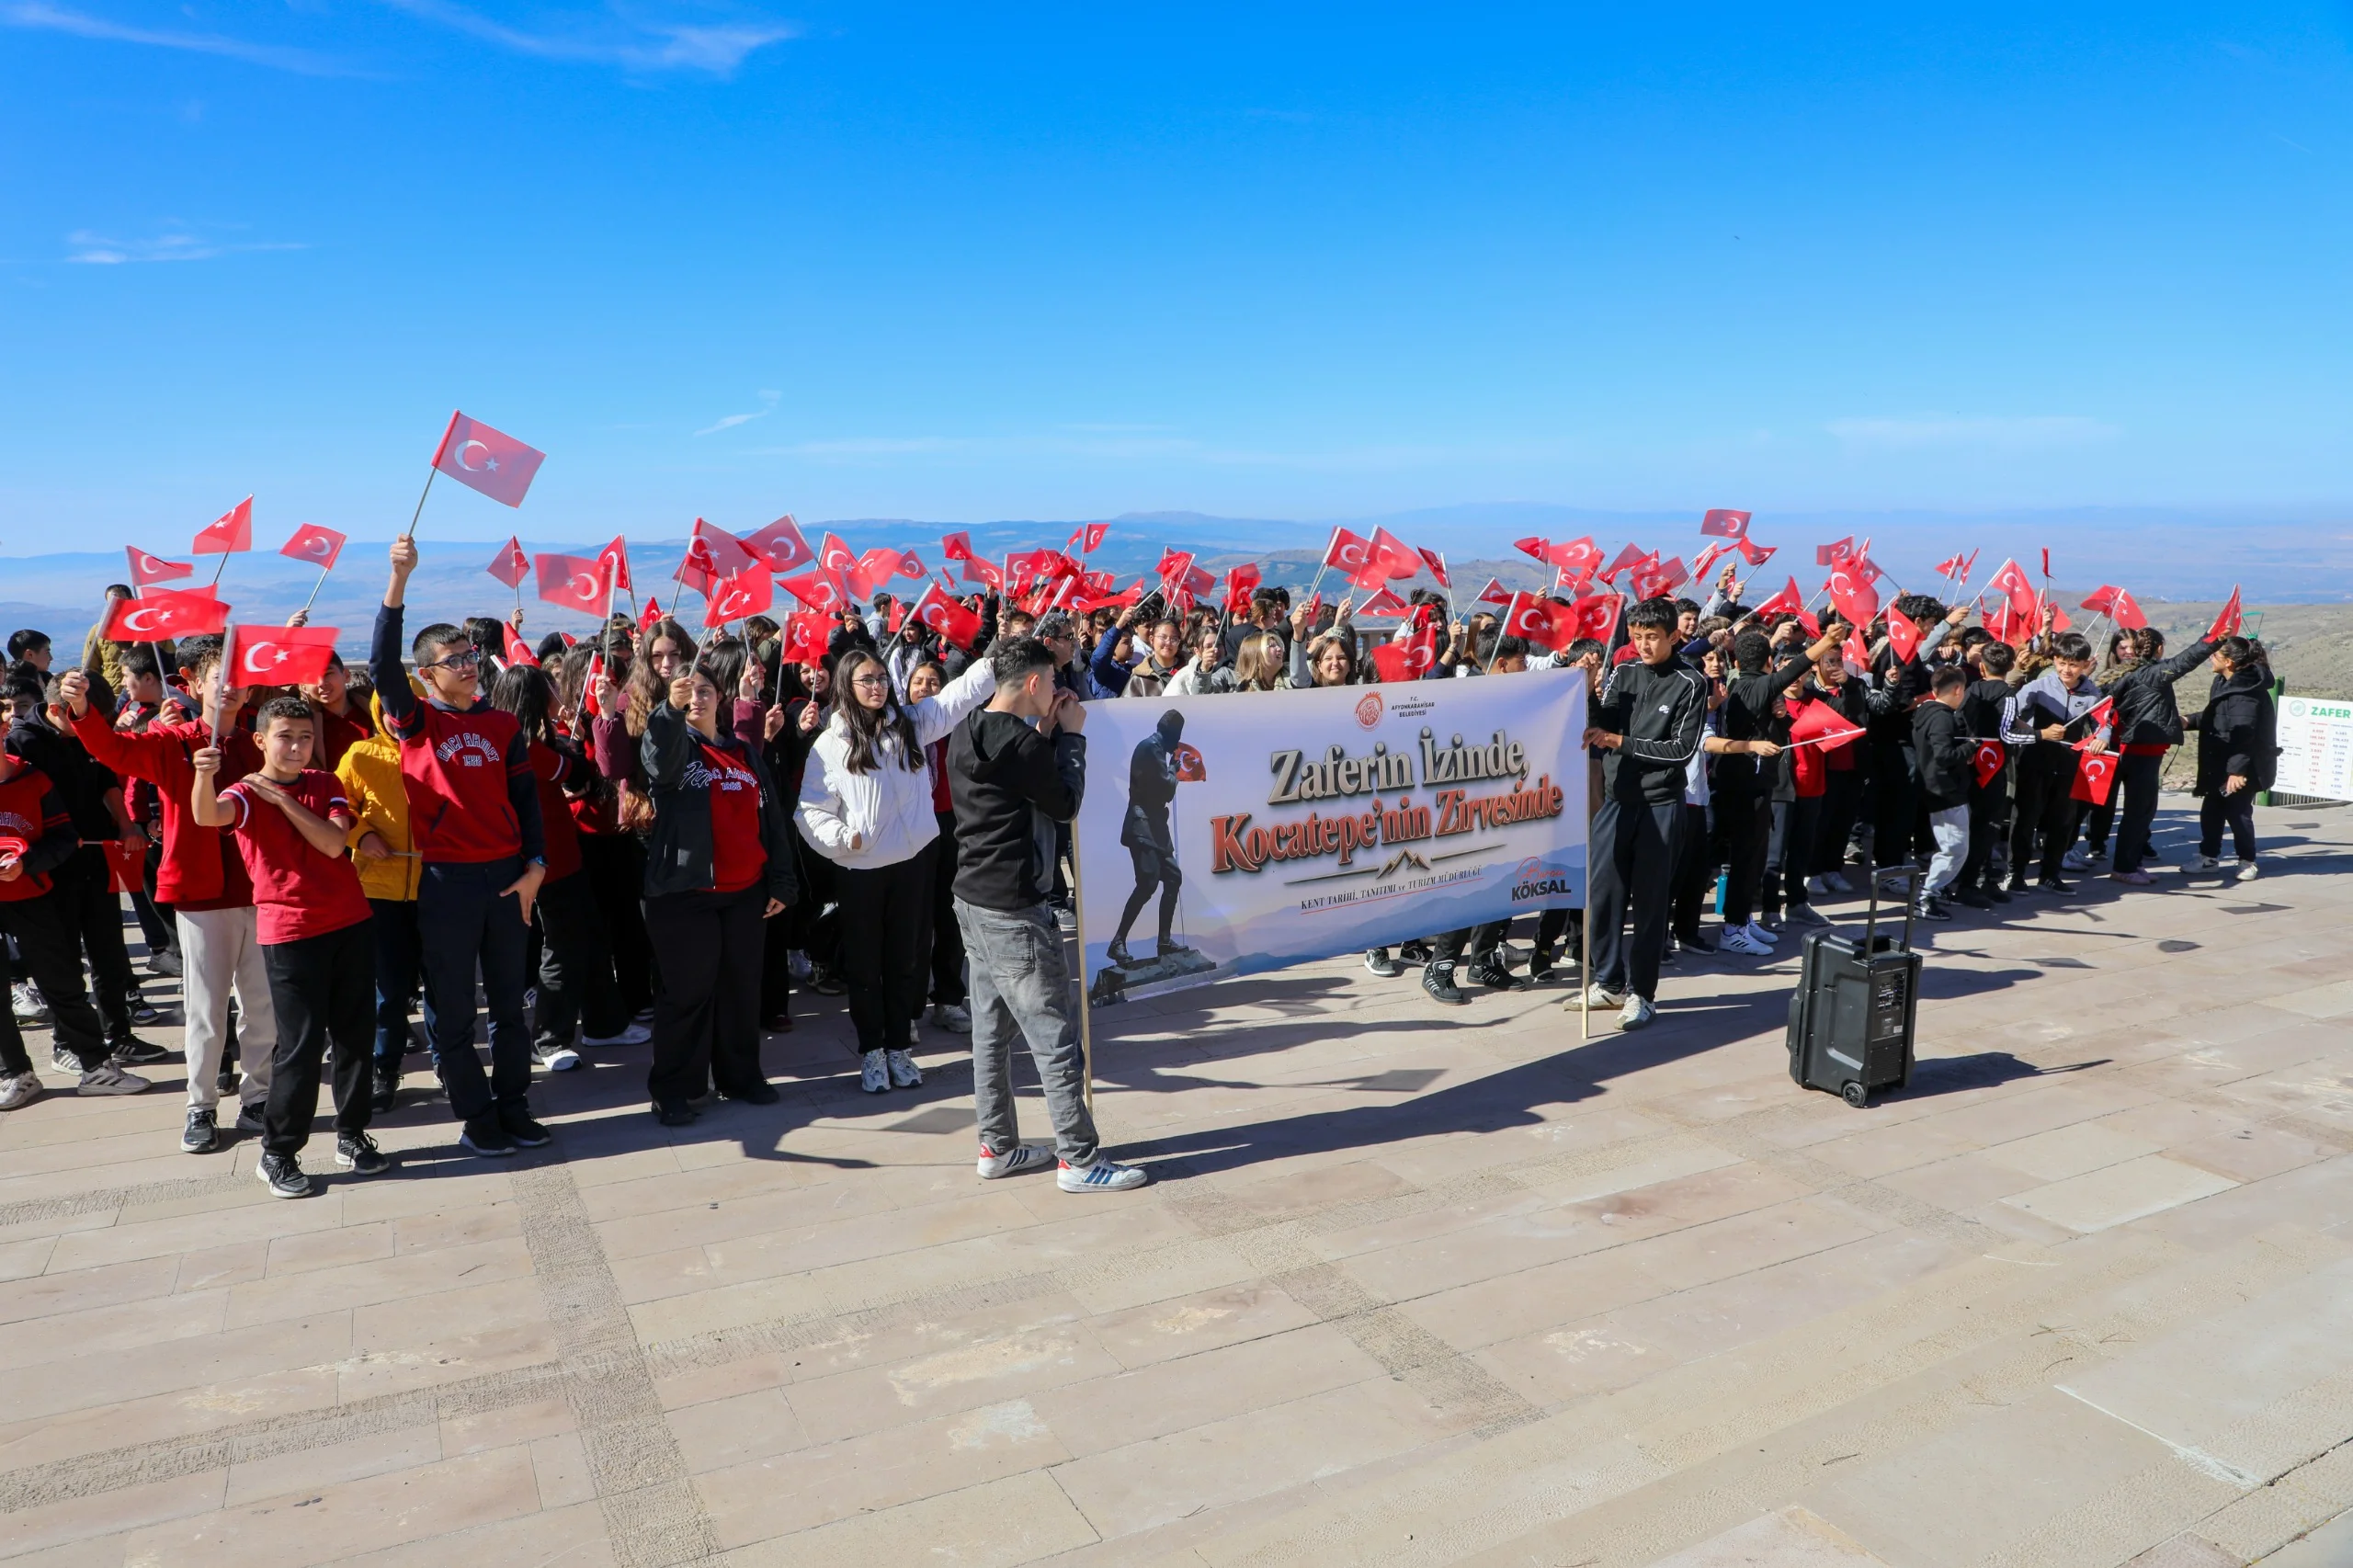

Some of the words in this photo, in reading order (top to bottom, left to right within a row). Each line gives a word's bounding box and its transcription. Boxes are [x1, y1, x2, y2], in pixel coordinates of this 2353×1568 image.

[1399, 709, 1427, 718] BELEDİYESİ
[2311, 706, 2351, 719] ZAFER
[436, 734, 463, 762] HACI
[463, 733, 500, 762] AHMET
[1267, 741, 1415, 805] Zaferin
[1420, 726, 1530, 787] İzinde,
[1435, 773, 1564, 837] Zirvesinde
[1301, 897, 1324, 910] KENT
[1360, 883, 1396, 899] TANITIMI
[1408, 875, 1437, 890] TURİZM
[1438, 865, 1483, 883] MÜDÜRLÜĞÜ
[1511, 880, 1572, 902] KÖKSAL
